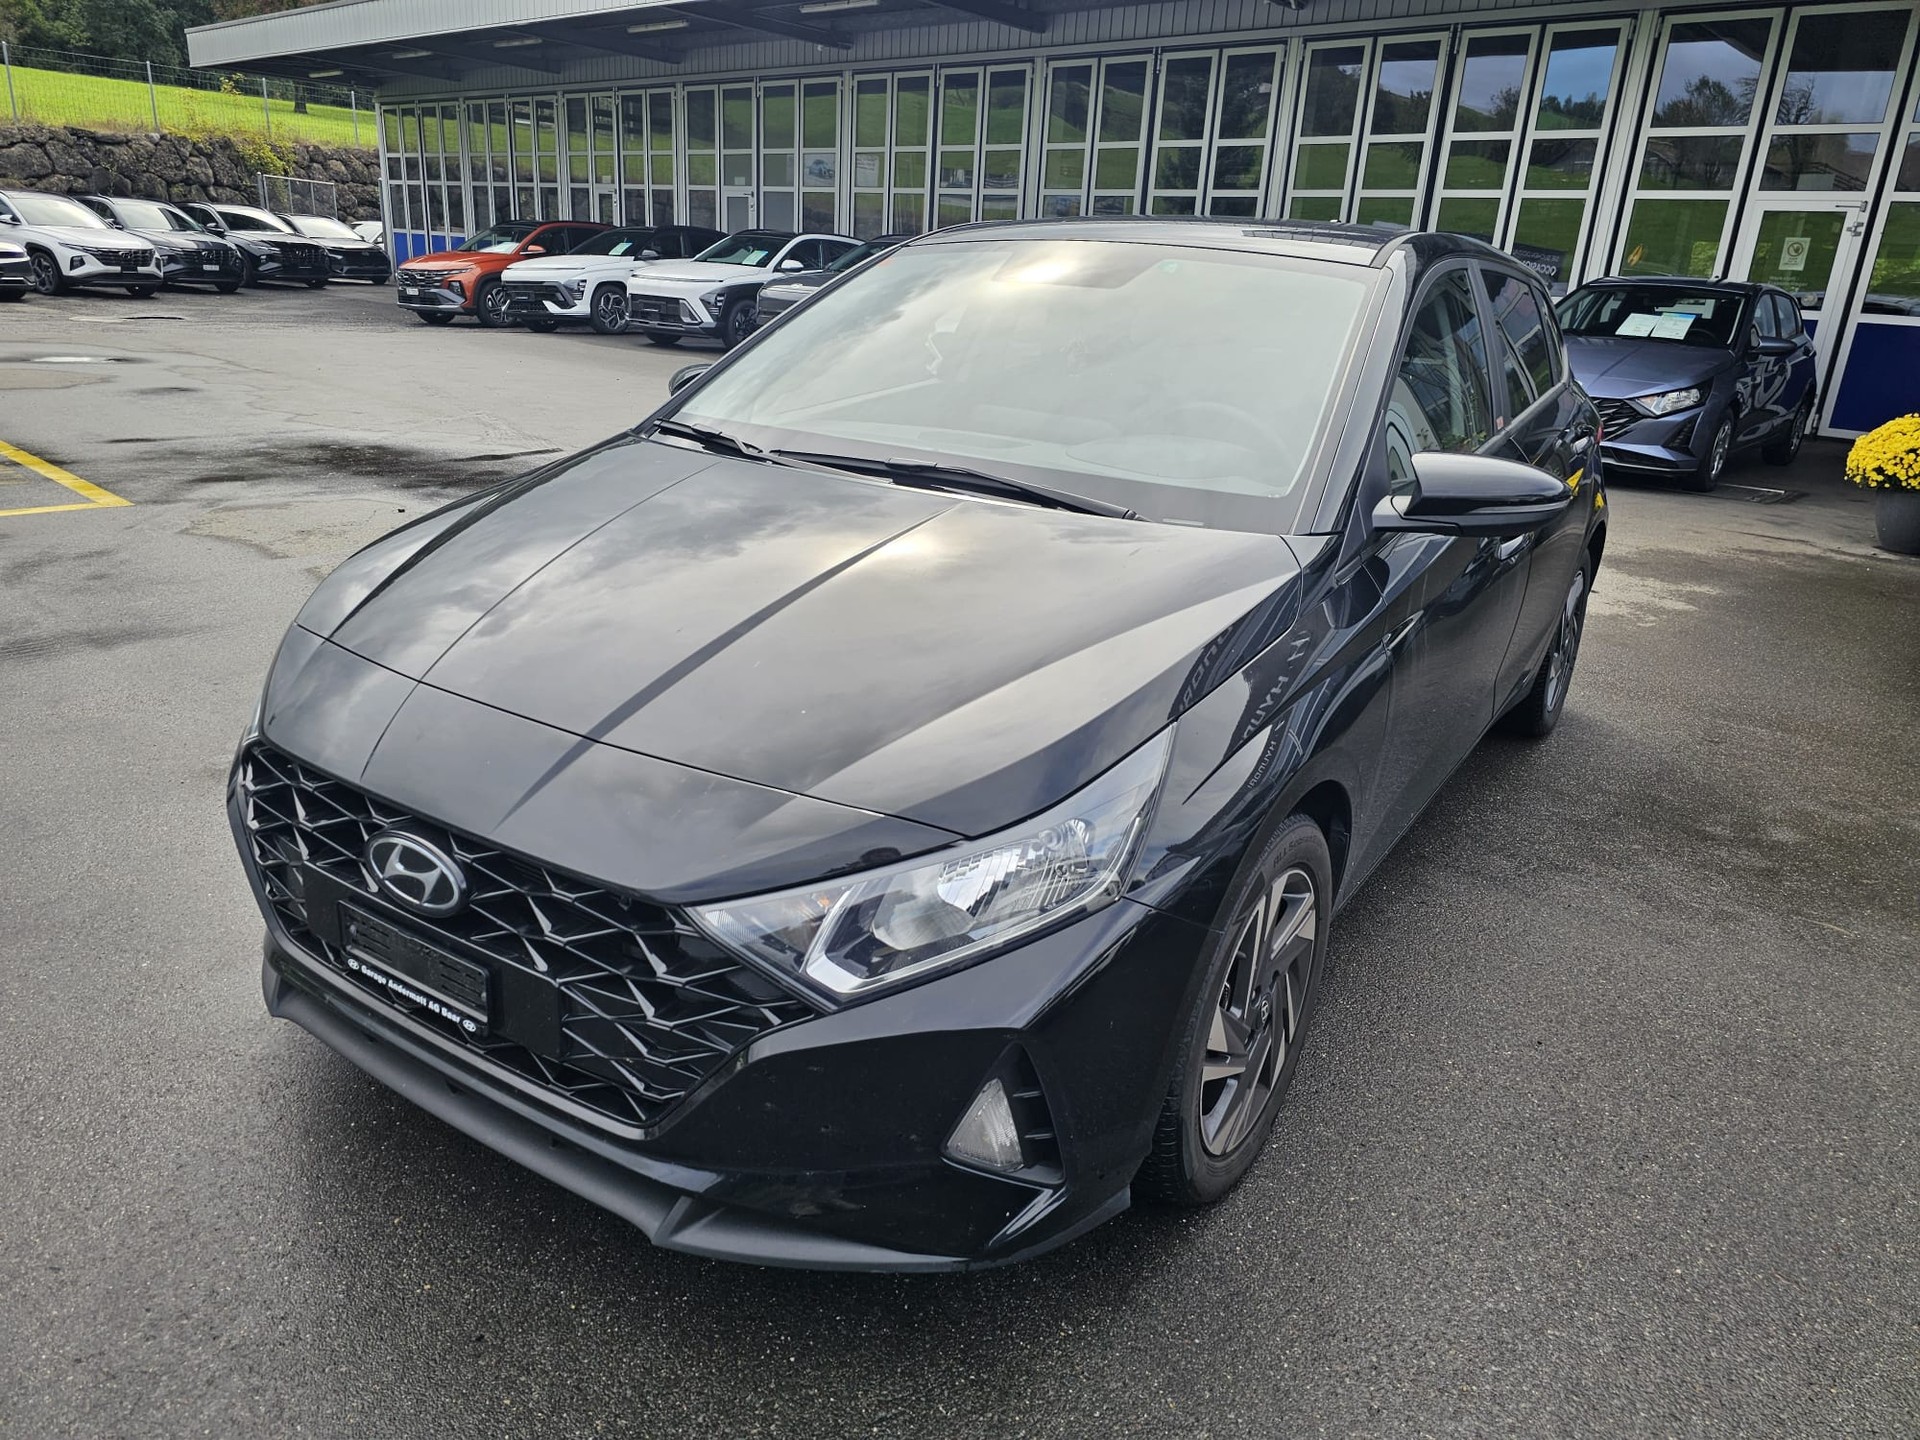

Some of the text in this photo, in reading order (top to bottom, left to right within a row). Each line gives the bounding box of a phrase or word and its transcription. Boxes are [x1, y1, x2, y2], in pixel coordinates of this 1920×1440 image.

[360, 964, 387, 985] Garage
[387, 979, 427, 1007] Andermatt
[428, 1000, 441, 1014] AG
